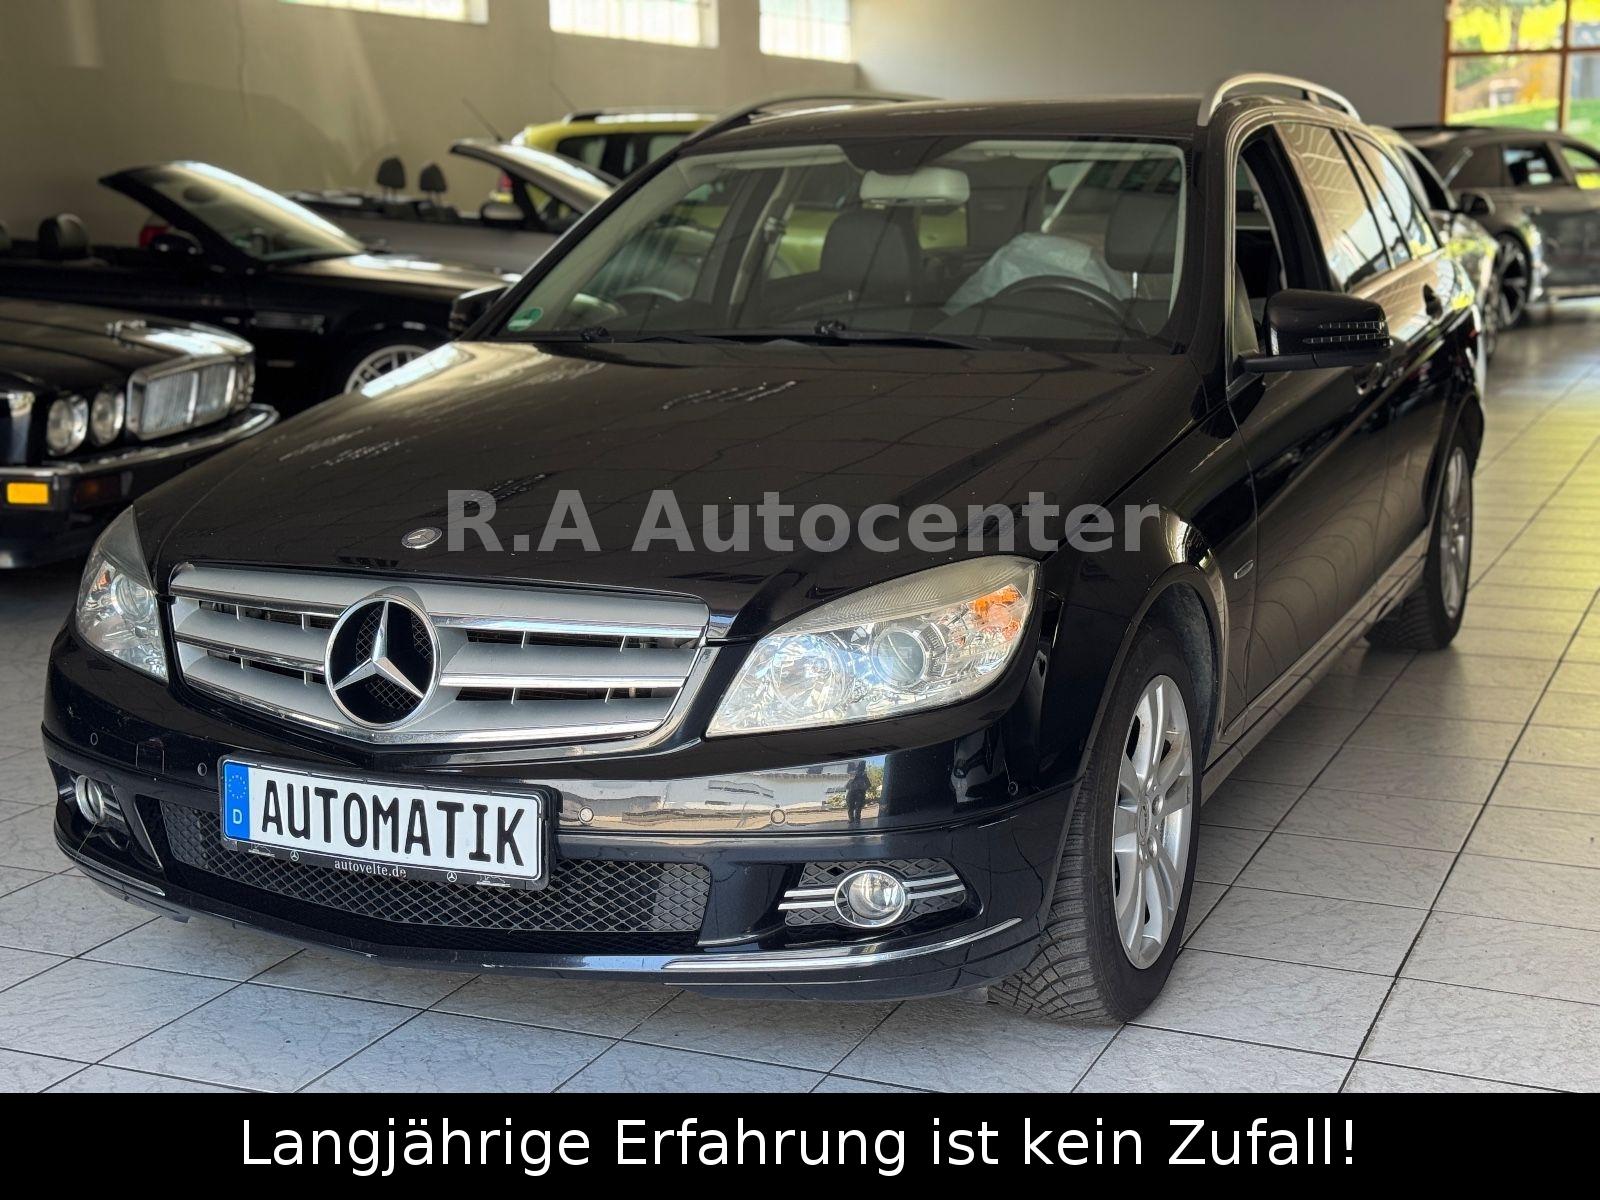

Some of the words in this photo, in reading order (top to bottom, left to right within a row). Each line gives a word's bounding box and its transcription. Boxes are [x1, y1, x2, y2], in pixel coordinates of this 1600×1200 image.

[232, 807, 243, 825] D
[261, 779, 526, 867] AUTOMATIK
[334, 860, 407, 879] autovelte.de
